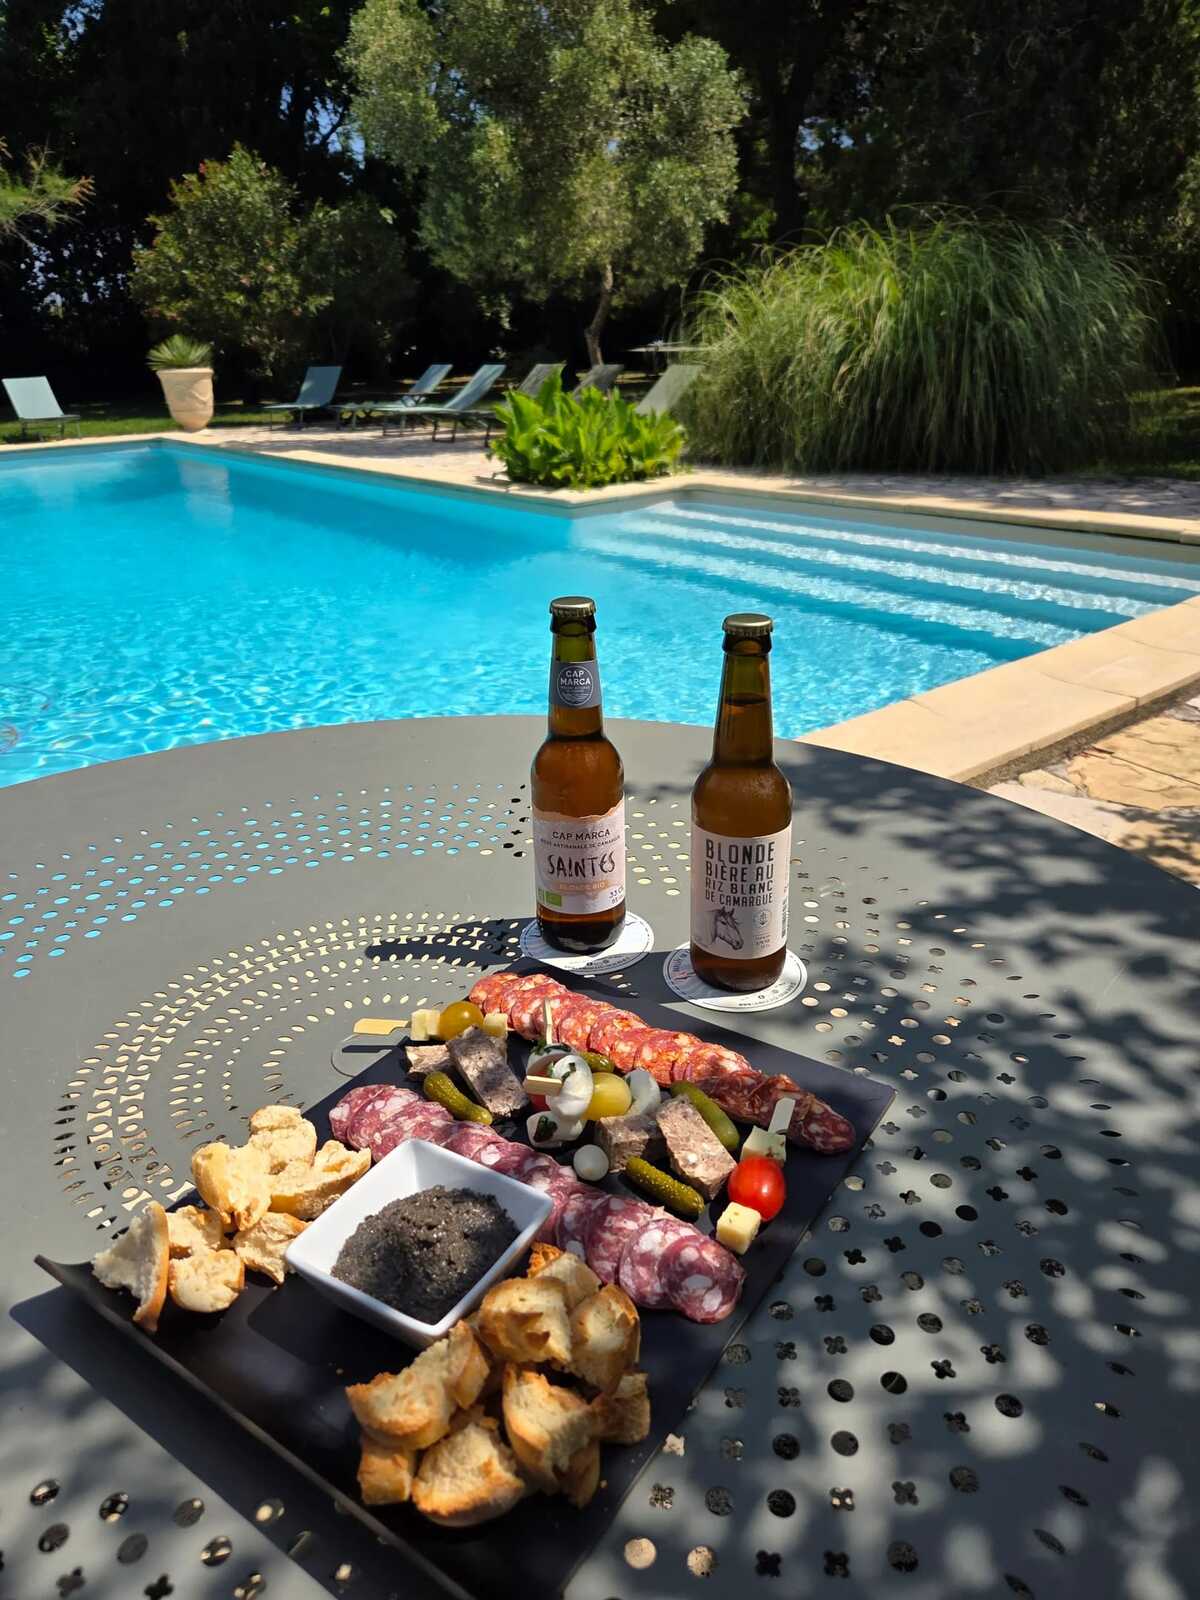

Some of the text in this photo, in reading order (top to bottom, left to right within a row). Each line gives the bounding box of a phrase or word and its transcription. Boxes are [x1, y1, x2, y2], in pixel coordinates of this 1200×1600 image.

[560, 677, 591, 686] MARCA
[565, 670, 585, 678] CAP
[552, 828, 611, 841] CAP MARCA
[705, 839, 775, 865] BLONDE
[704, 860, 774, 882] BIÈRE AU
[705, 877, 724, 893] RIZ
[730, 880, 773, 895] BLANC
[705, 889, 774, 908] DE CAMARGUE
